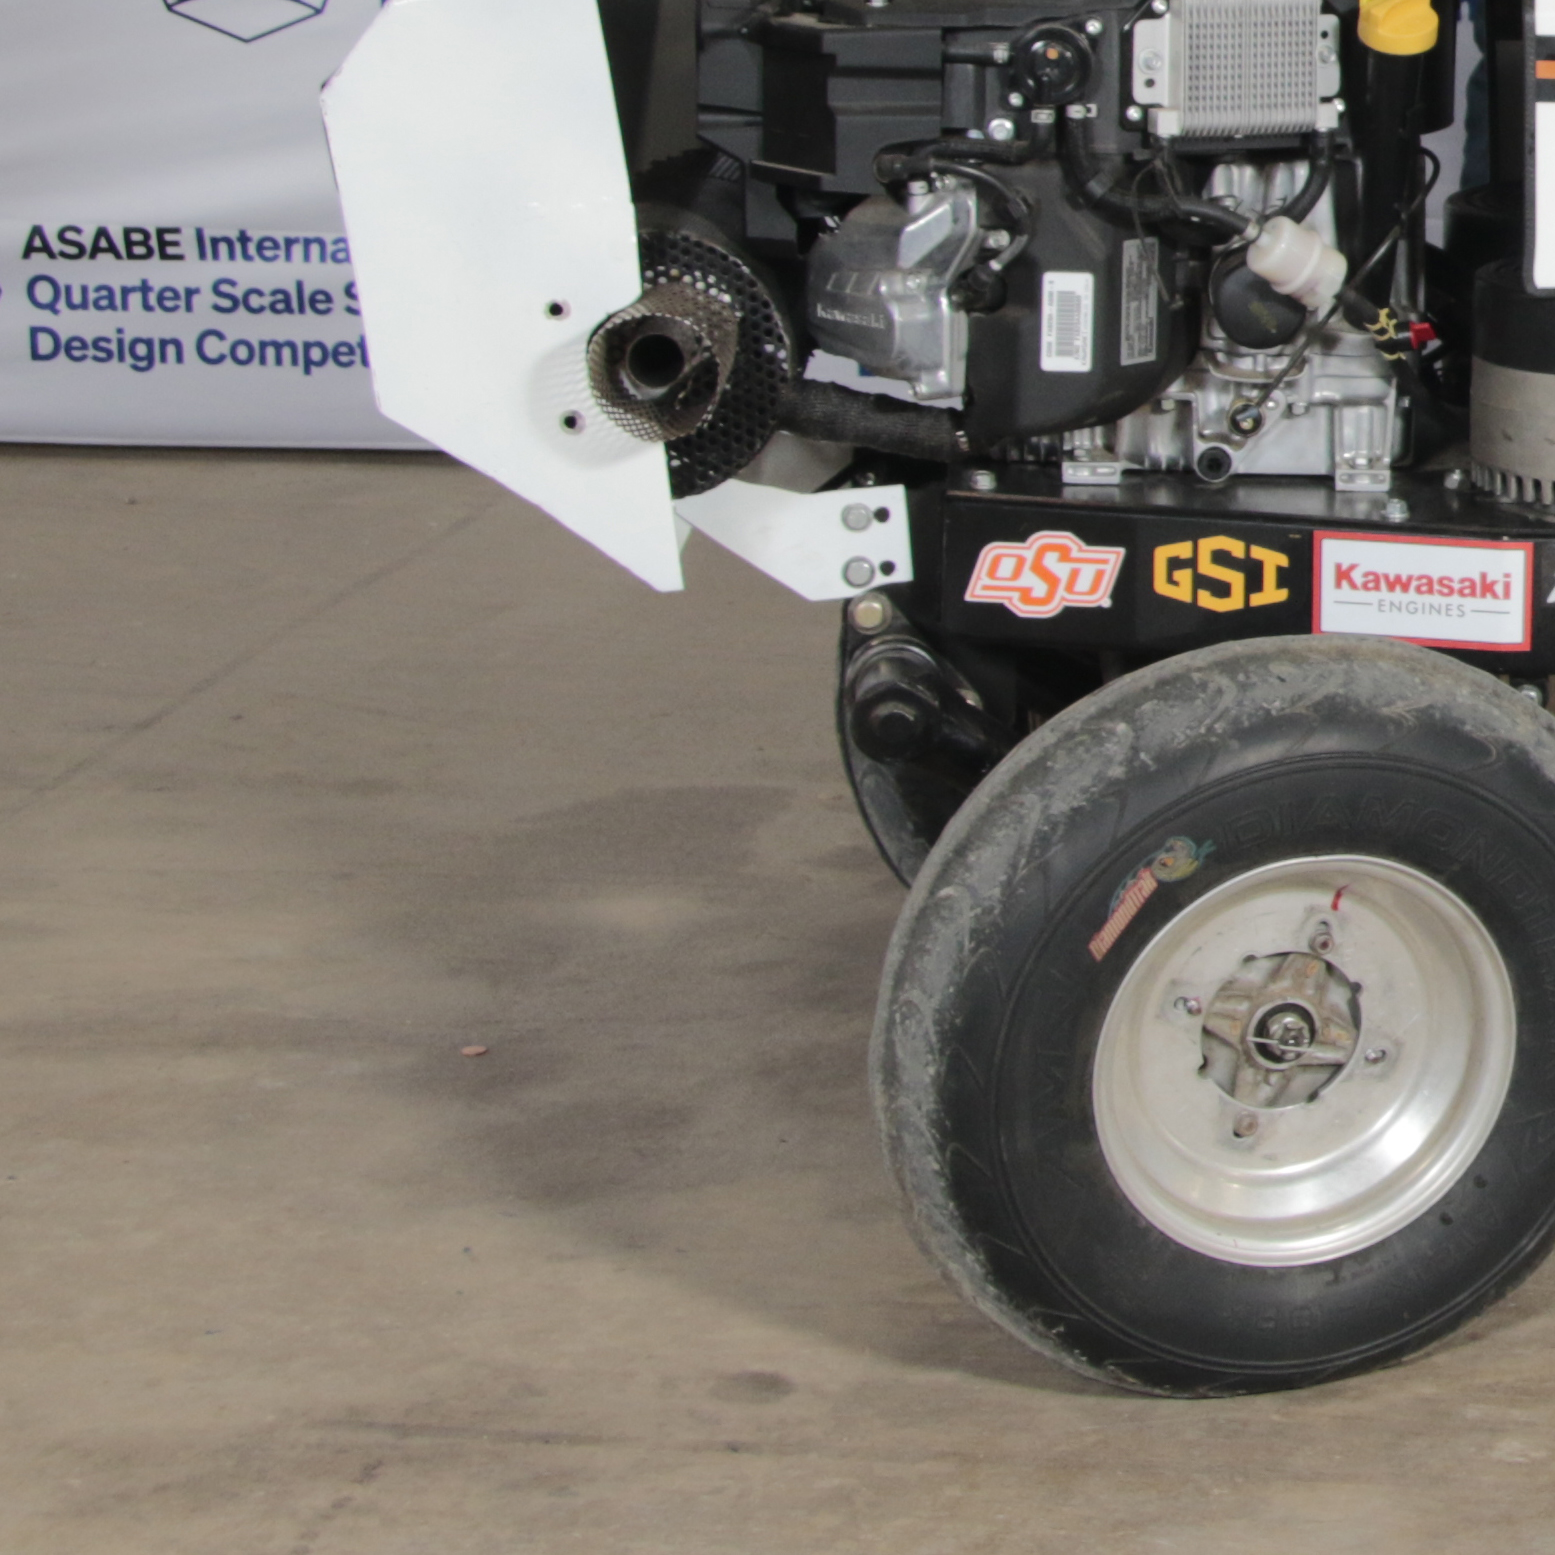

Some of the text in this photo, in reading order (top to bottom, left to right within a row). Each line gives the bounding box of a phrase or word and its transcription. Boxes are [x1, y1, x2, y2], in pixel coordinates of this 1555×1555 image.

[21, 224, 351, 264] ASABE Interna
[26, 274, 334, 316] Quarter Scale
[29, 325, 371, 373] Design Compet
[968, 532, 1124, 617] OSU
[1153, 535, 1290, 614] GSI
[1333, 562, 1513, 601] Kawasaki
[1377, 600, 1467, 619] ENGINES
